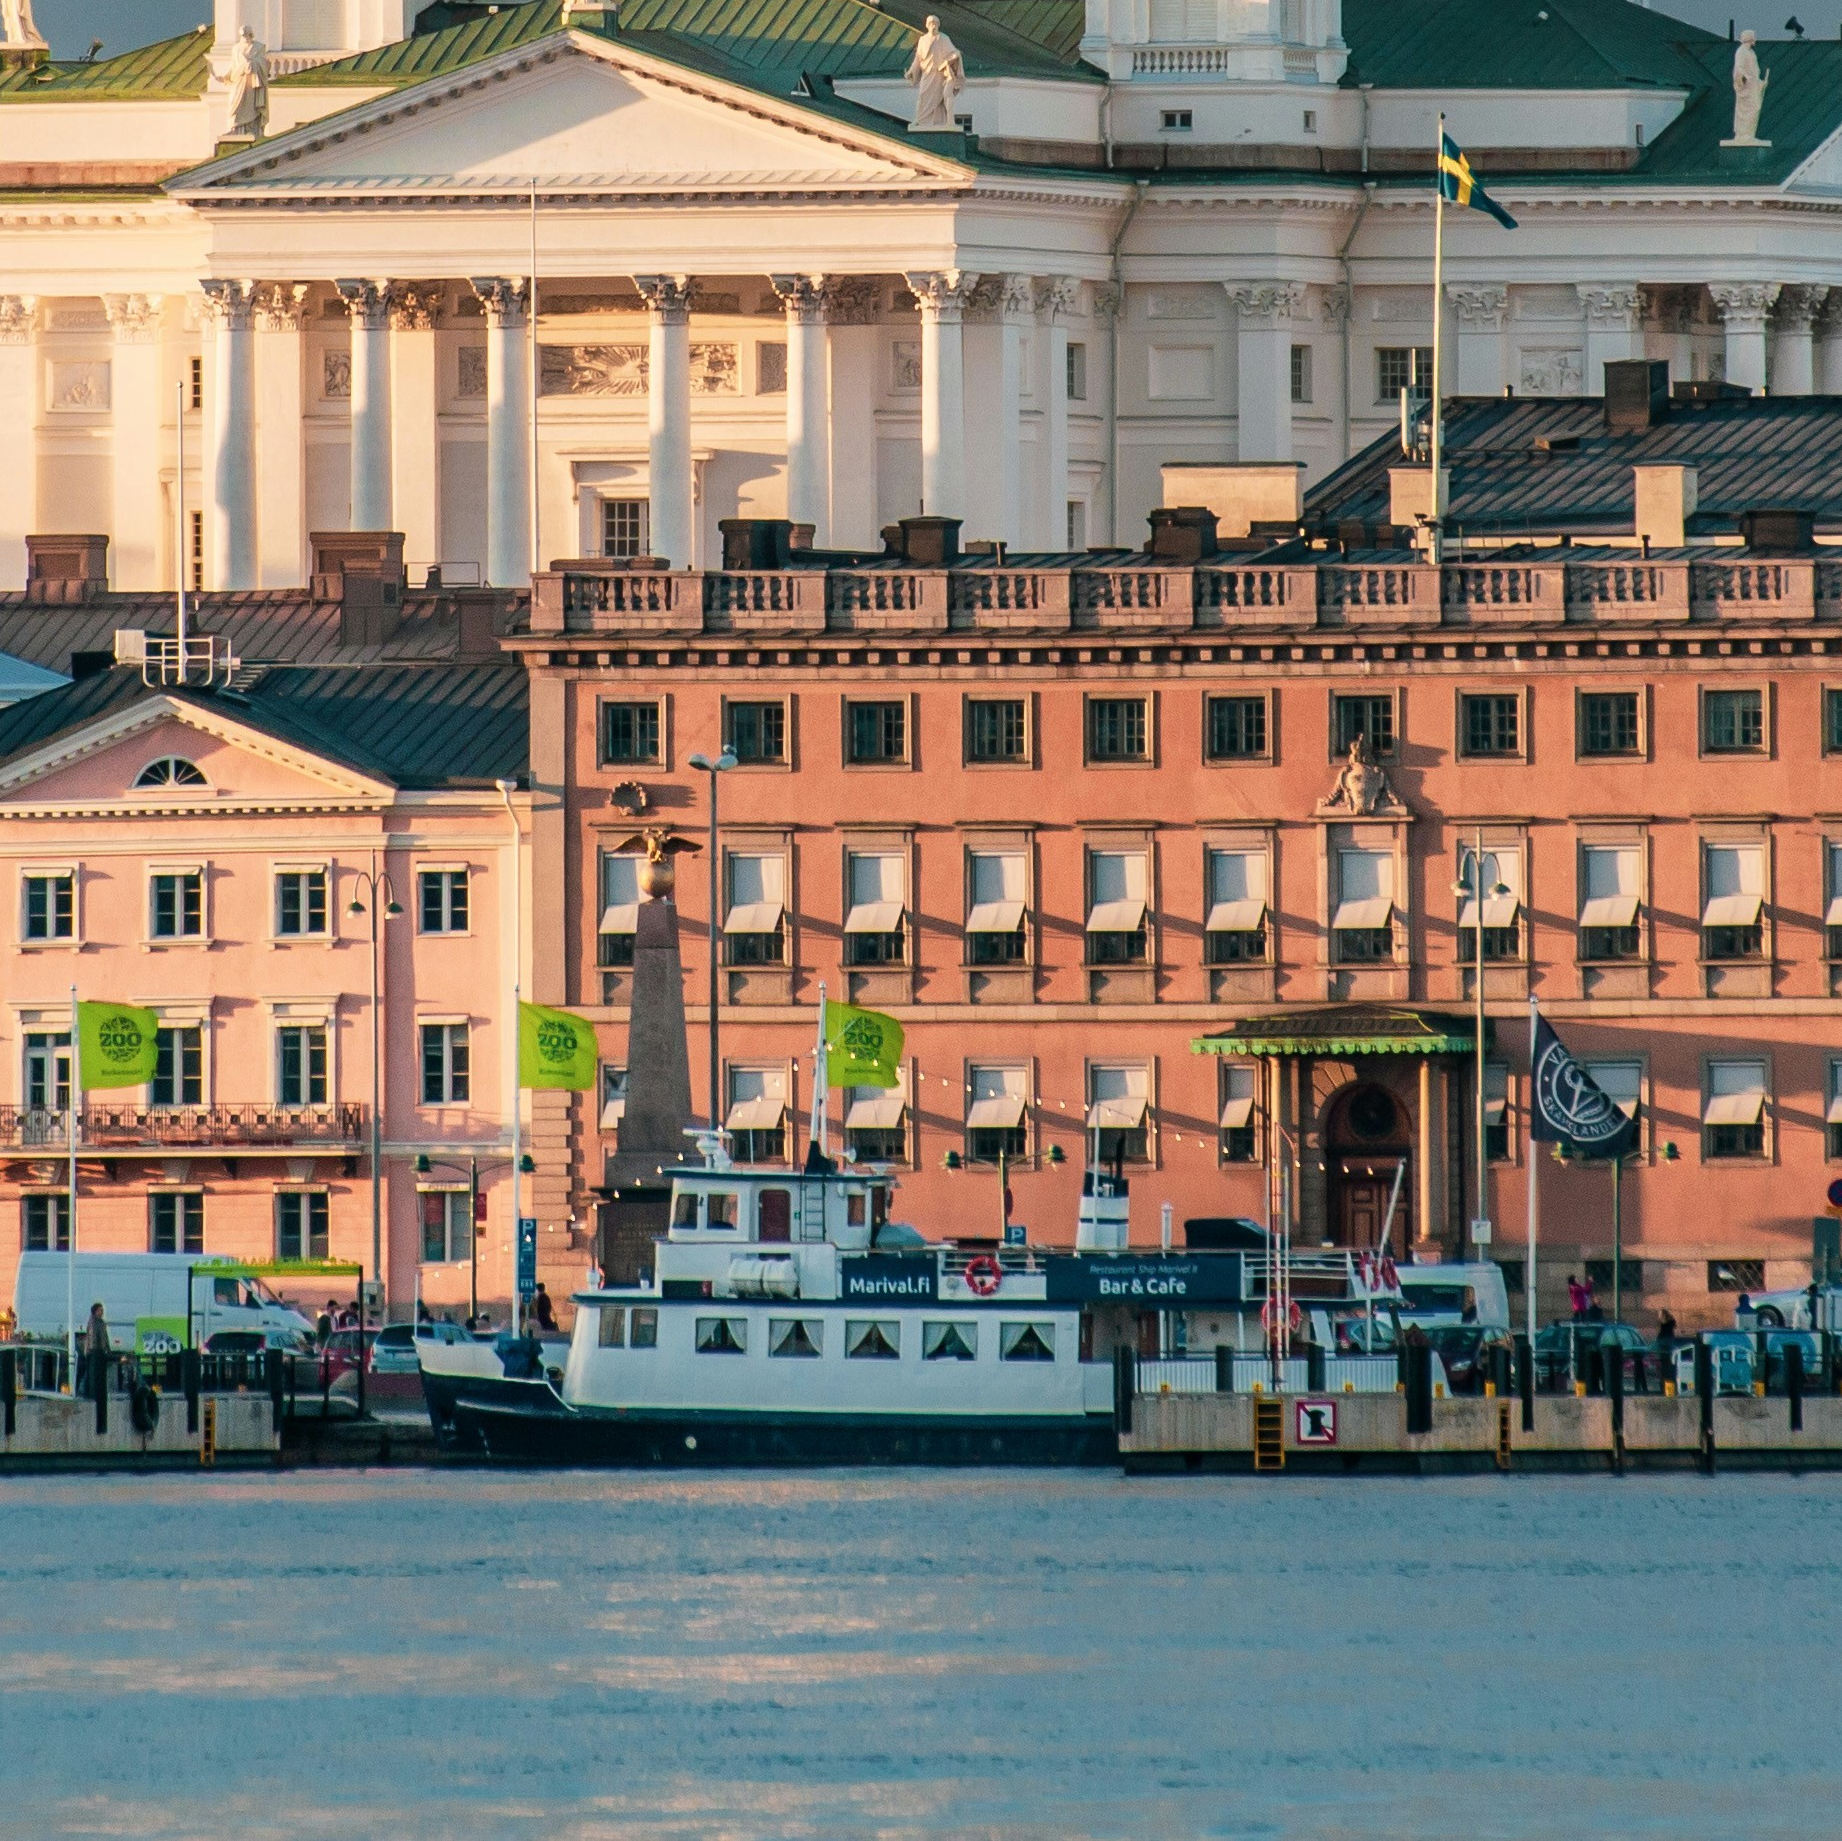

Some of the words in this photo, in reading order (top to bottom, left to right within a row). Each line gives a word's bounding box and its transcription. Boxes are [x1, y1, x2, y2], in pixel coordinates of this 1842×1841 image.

[99, 1032, 142, 1047] ZOO
[537, 1034, 578, 1050] ZOO
[844, 1032, 883, 1048] ZOO
[522, 1220, 534, 1236] P
[1011, 1228, 1023, 1240] P
[1089, 1264, 1136, 1275] Restaurant
[1138, 1264, 1156, 1276] Ship
[849, 1276, 930, 1294] Marival.fi
[1099, 1277, 1129, 1294] Bar
[1130, 1278, 1144, 1295] &
[1146, 1276, 1187, 1295] Cafe
[143, 1339, 182, 1355] ZOO
